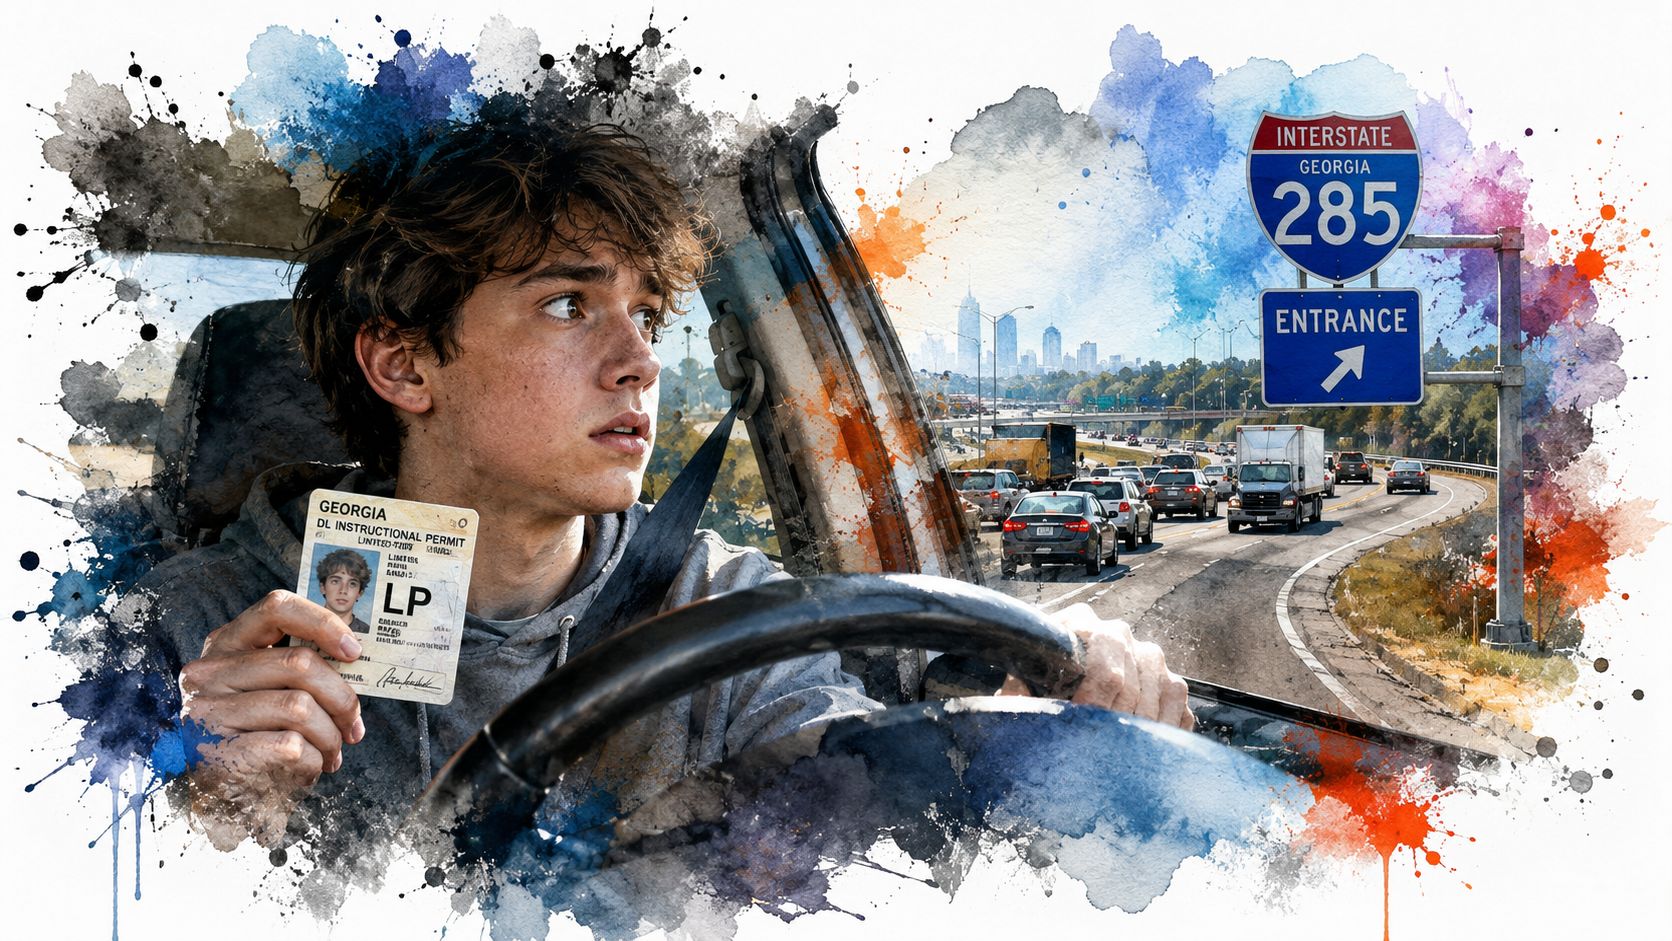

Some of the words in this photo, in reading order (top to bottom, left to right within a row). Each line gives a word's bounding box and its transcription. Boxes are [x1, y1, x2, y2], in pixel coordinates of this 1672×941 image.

[1277, 126, 1392, 147] INTERSTATE
[1300, 159, 1371, 174] GEORGIA
[1272, 180, 1400, 246] 285
[1276, 308, 1408, 334] ENTRANCE
[319, 500, 387, 521] GEORGIA
[317, 518, 331, 529] DL
[335, 520, 422, 542] INSTRUCTIONAL
[425, 533, 466, 548] PERMIT
[383, 582, 432, 616] LP
